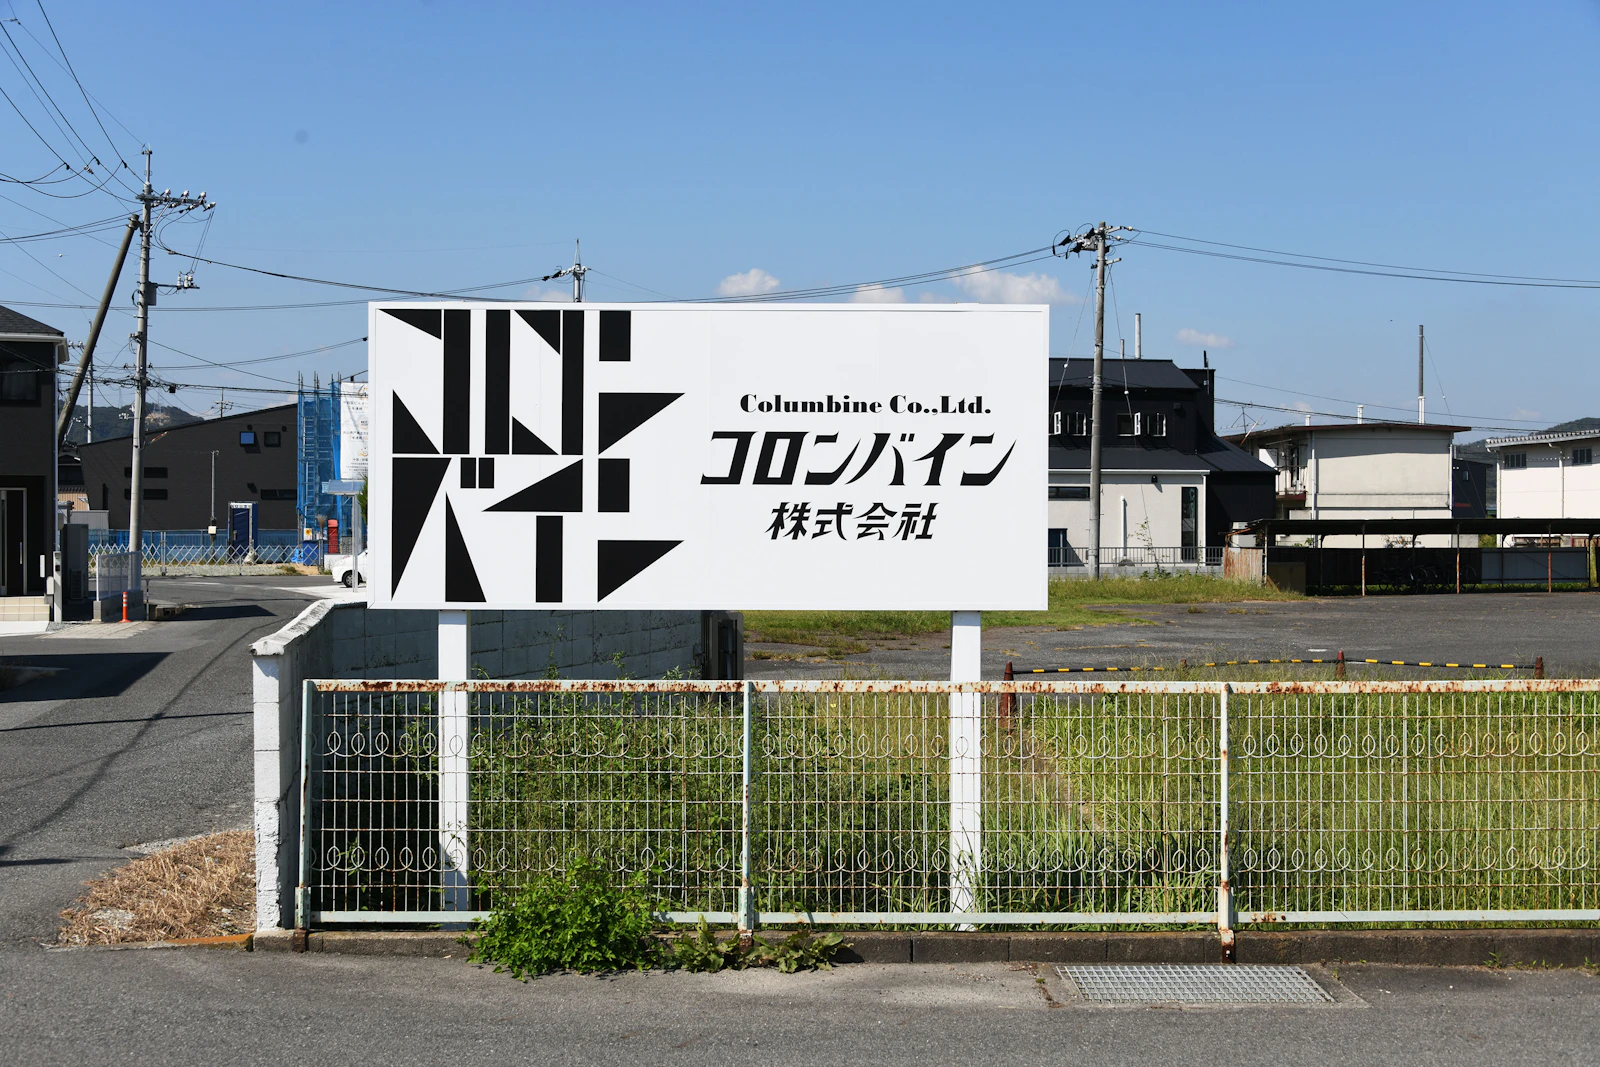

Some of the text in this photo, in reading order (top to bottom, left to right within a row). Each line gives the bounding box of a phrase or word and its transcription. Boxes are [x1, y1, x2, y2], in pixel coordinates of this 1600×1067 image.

[740, 394, 992, 415] Columbine Co.,Ltd.
[700, 430, 1017, 487] コロンバイン
[765, 501, 938, 540] 株式会社
